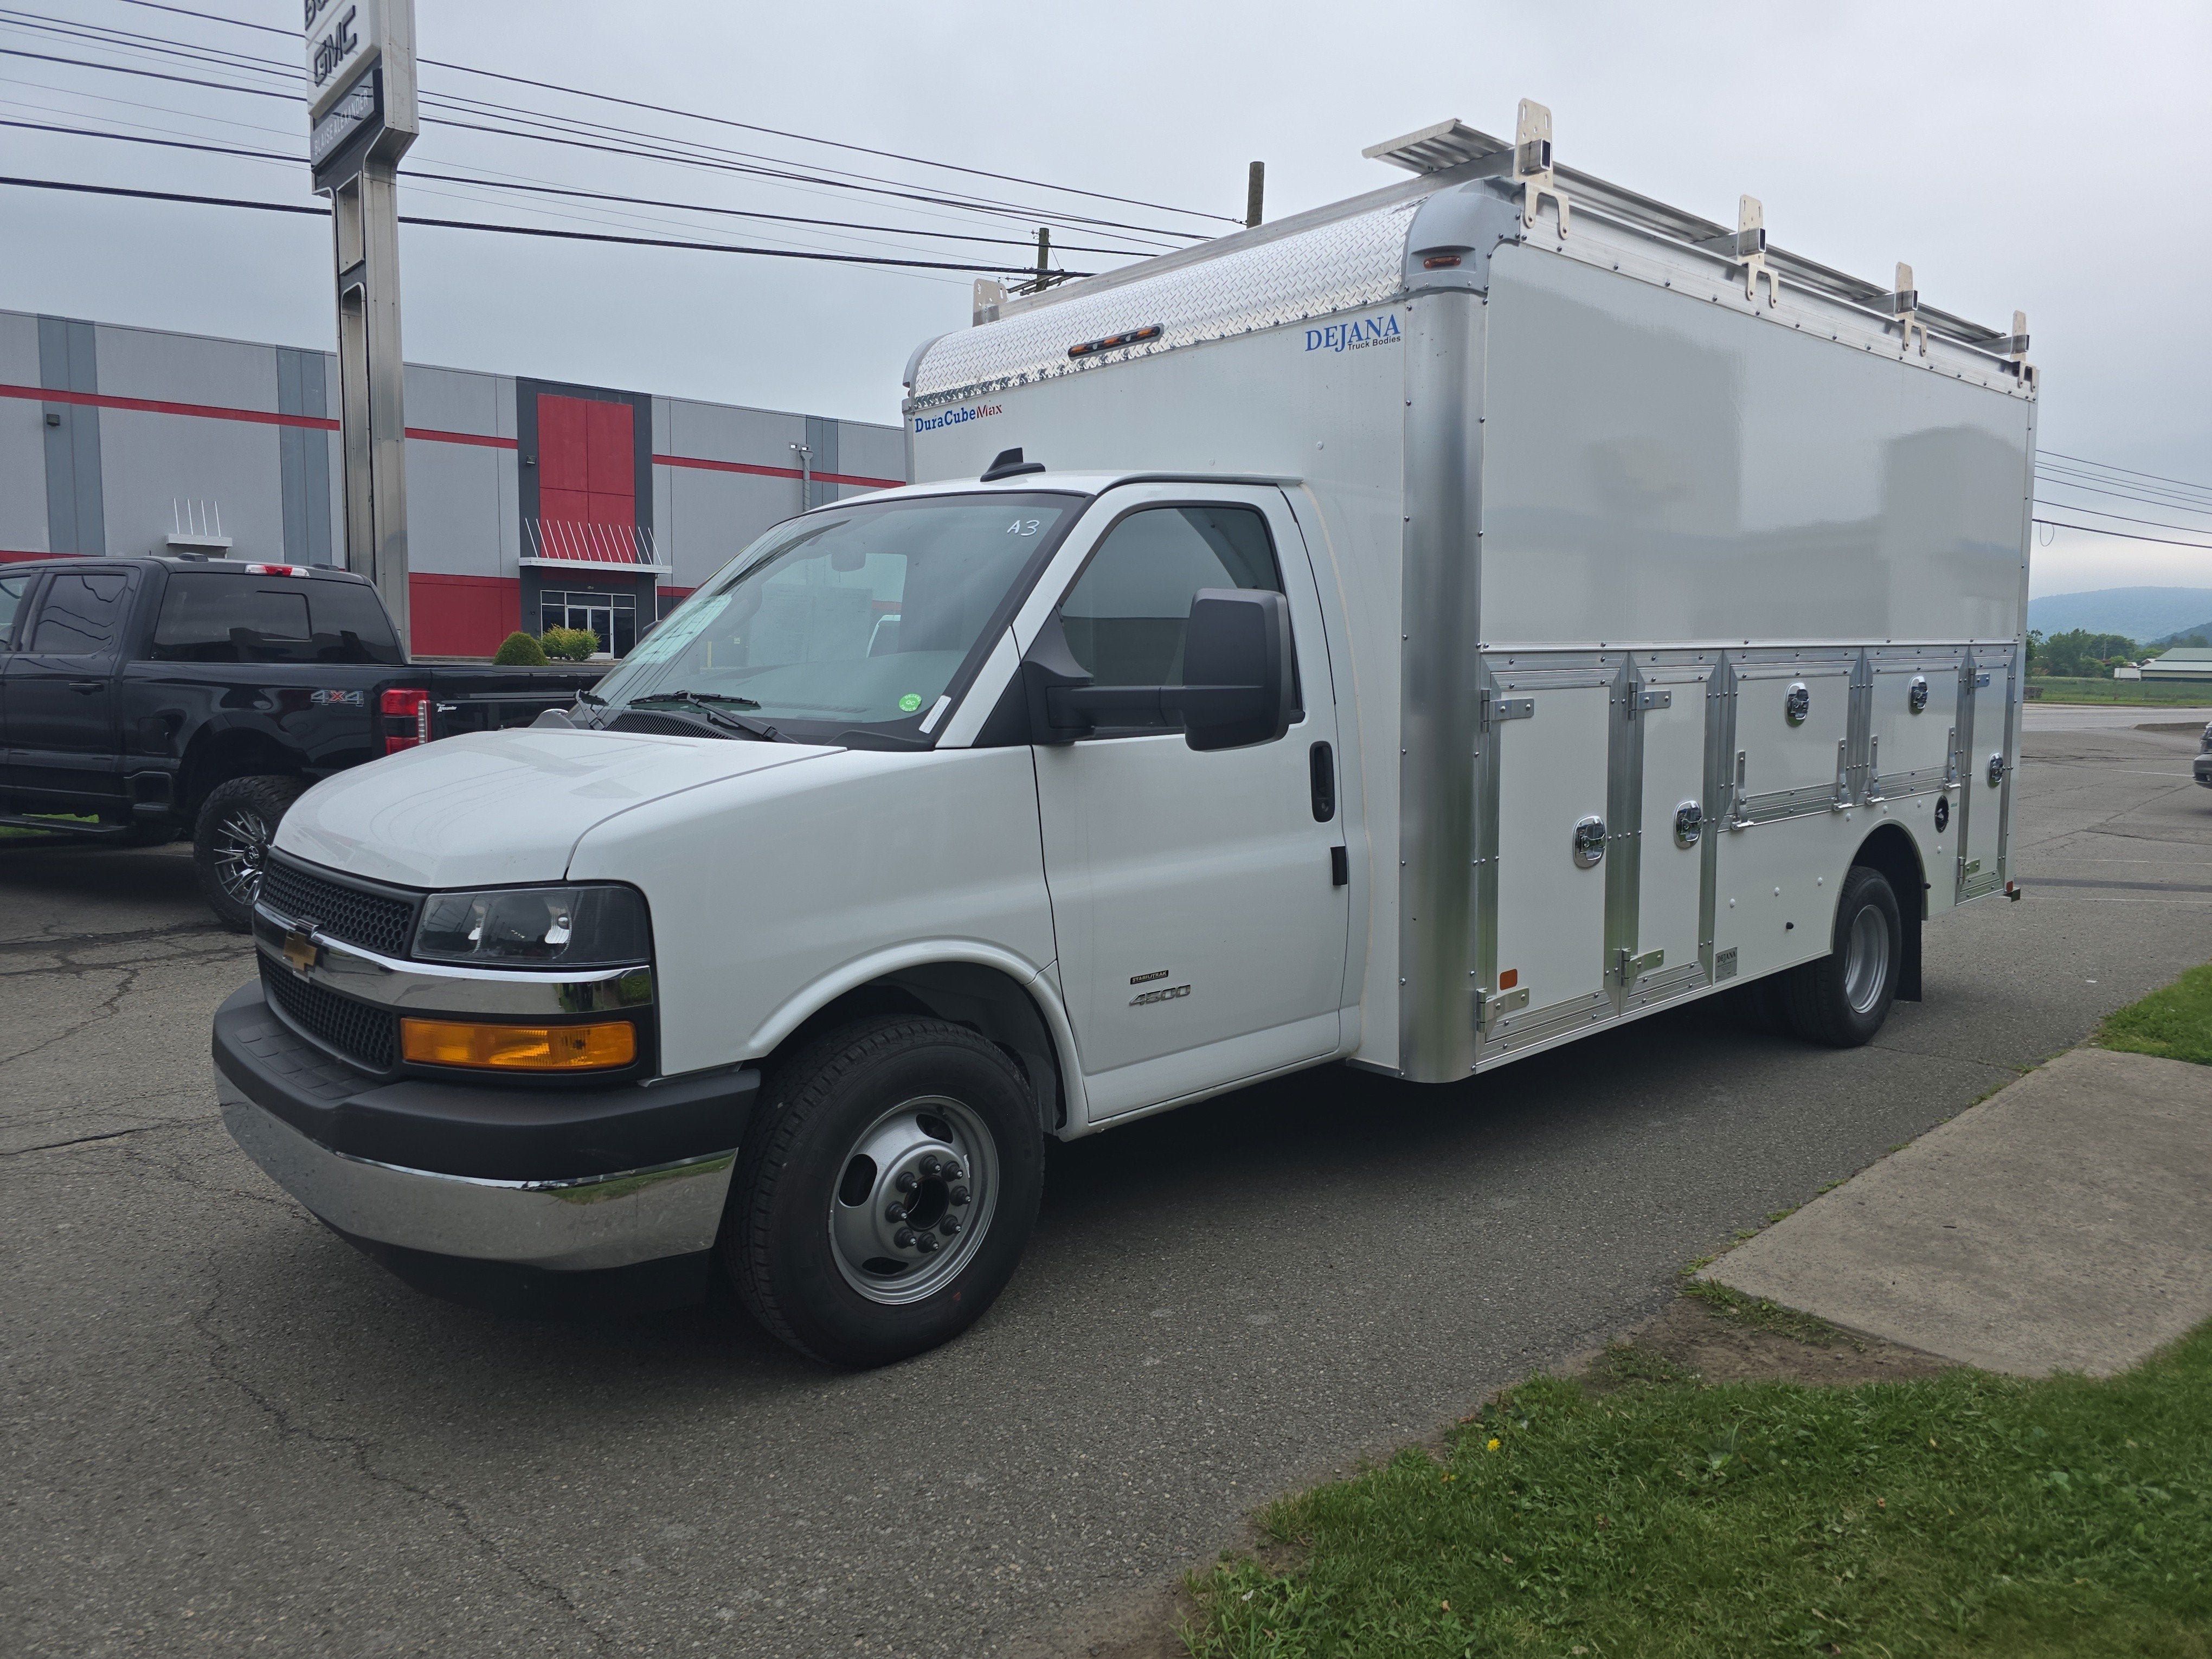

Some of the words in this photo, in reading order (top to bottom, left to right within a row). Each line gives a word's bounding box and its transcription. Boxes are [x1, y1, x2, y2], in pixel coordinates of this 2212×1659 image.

[314, 5, 358, 87] GMC
[314, 123, 333, 156] BLAISE
[334, 89, 368, 137] ALEXANDER
[1305, 314, 1400, 352] DEJANA
[1348, 340, 1369, 351] Truck
[1373, 336, 1401, 346] Bodies
[1007, 519, 1040, 537] A3
[1718, 951, 1736, 963] DEJANA
[1132, 970, 1167, 982] STABILITRAK
[1129, 983, 1191, 1006] 4500
